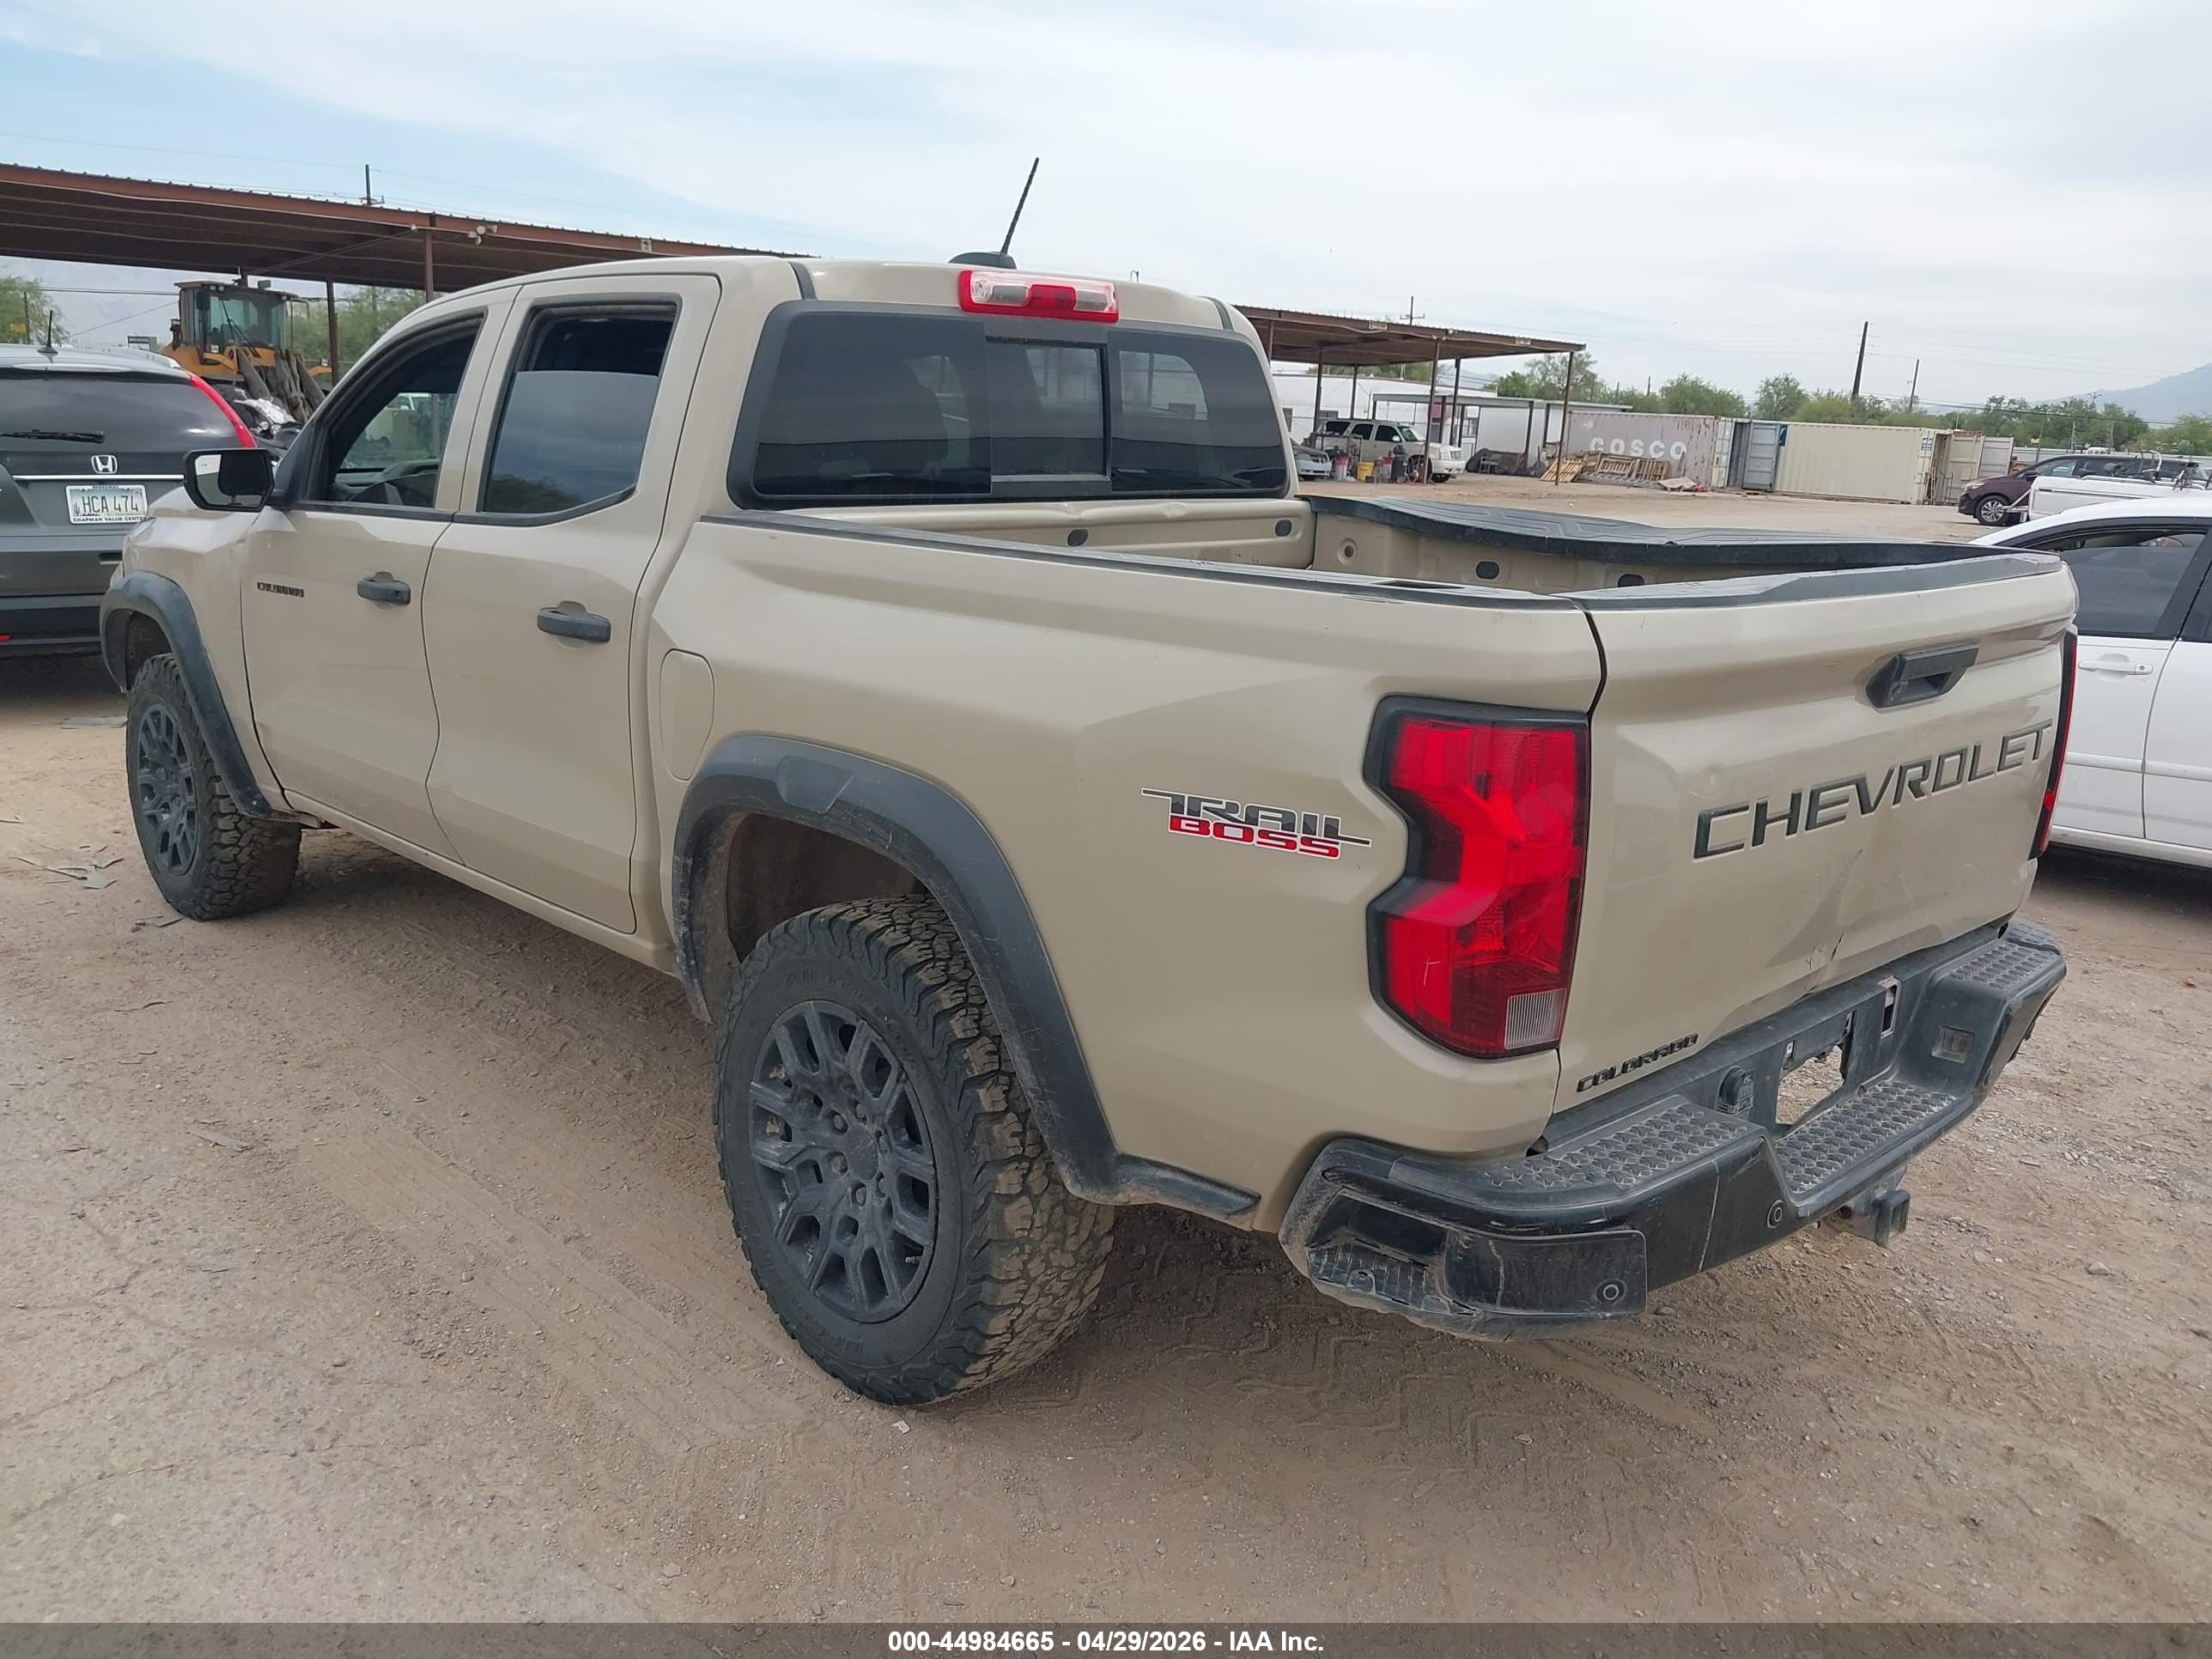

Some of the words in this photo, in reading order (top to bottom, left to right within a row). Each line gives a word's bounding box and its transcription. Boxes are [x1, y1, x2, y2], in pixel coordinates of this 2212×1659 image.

[1589, 437, 1686, 459] COSCO
[82, 495, 109, 513] HCA
[113, 495, 139, 513] 474
[1692, 720, 2053, 860] CHEVROLET
[1140, 787, 1371, 848] TRAIL
[1169, 814, 1341, 860] BOSS
[1577, 1032, 1698, 1092] COLORADO
